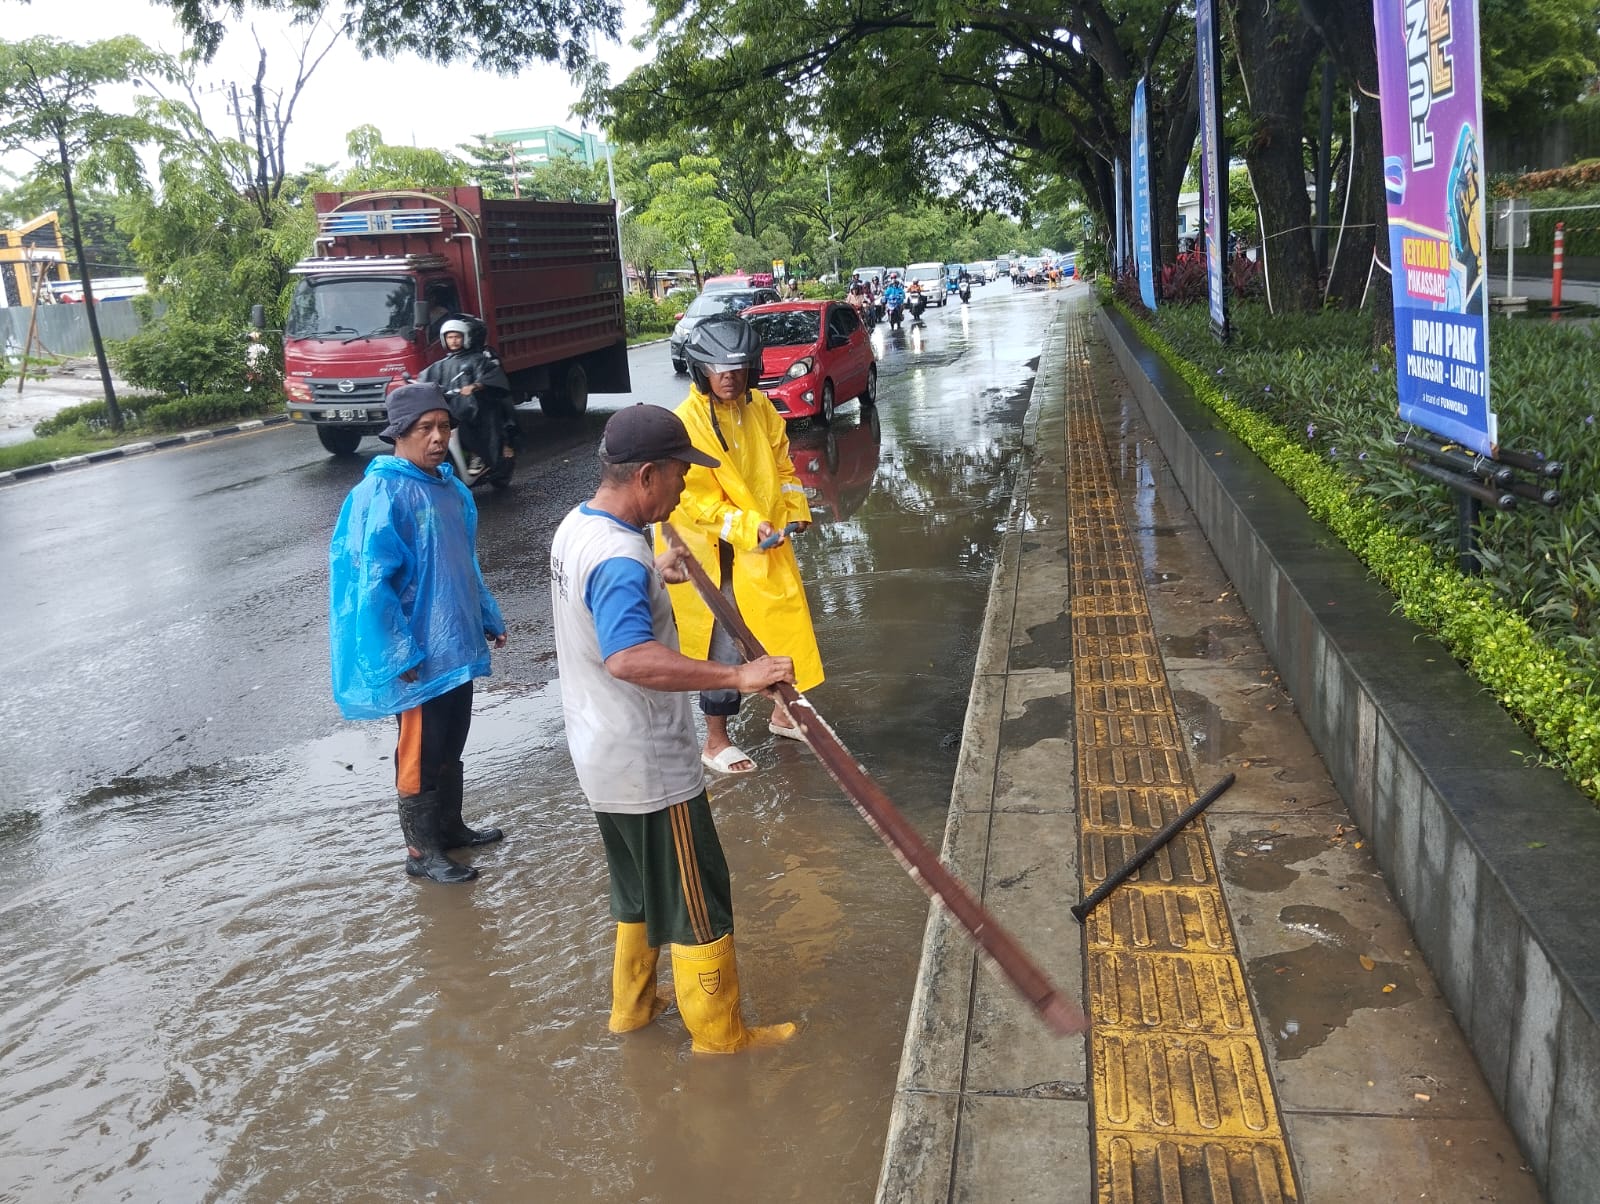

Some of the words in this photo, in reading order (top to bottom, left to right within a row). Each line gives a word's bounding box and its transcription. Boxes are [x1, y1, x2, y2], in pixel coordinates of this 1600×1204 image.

[1404, 0, 1434, 167] FUN
[1412, 319, 1443, 356] NIPAH
[1445, 323, 1477, 365] PARK
[1407, 353, 1444, 385] MAKASSAR
[1450, 363, 1478, 395] LANTAI
